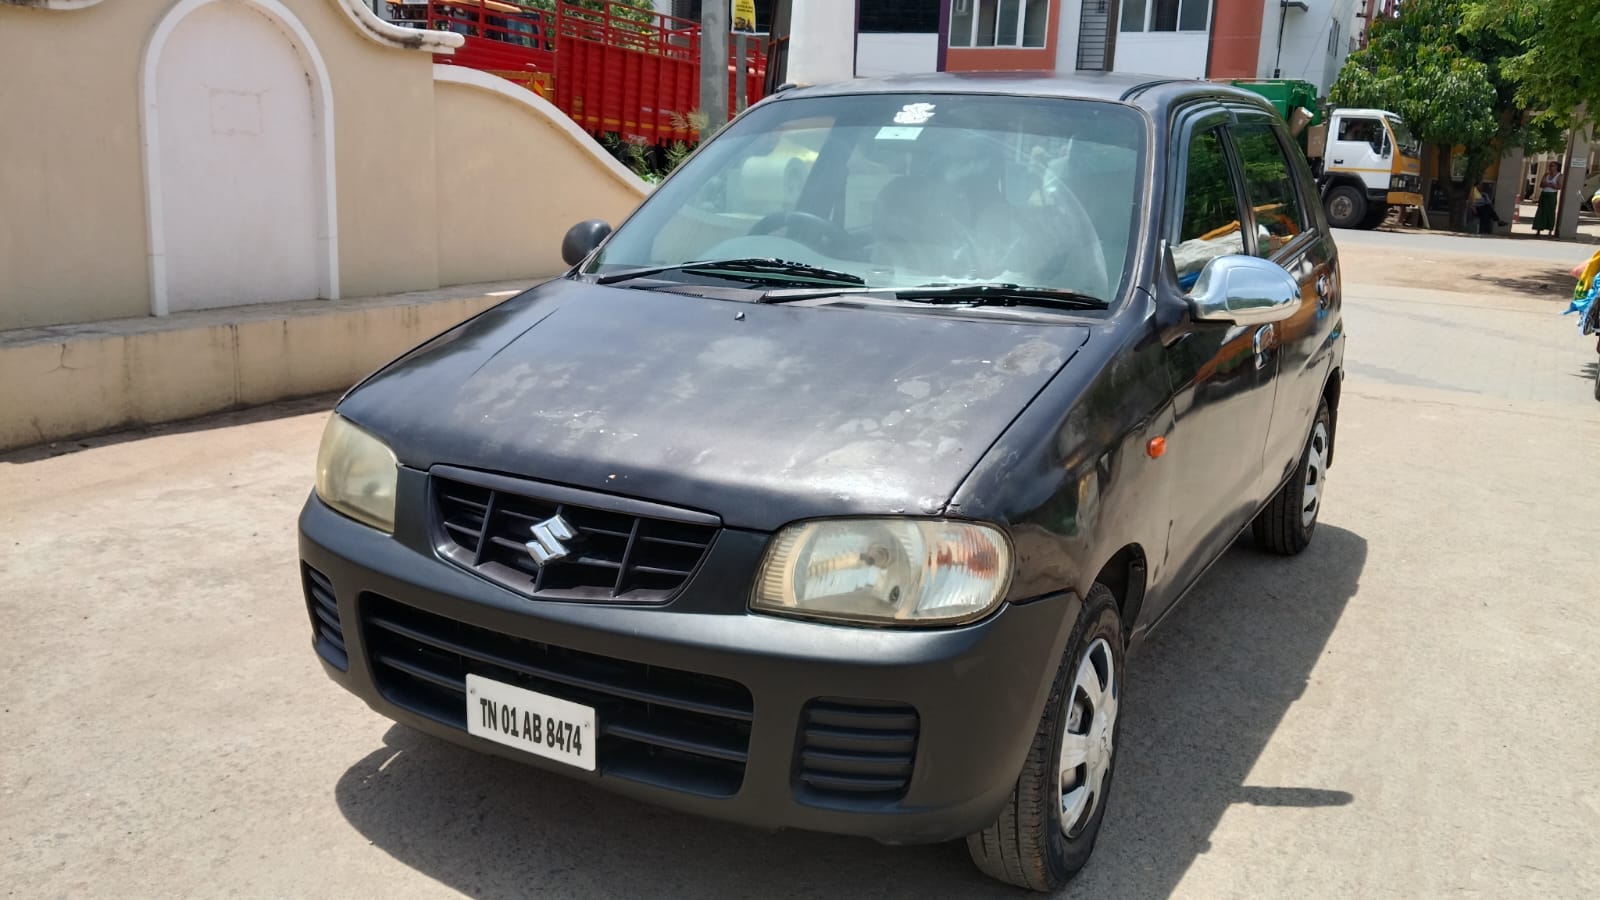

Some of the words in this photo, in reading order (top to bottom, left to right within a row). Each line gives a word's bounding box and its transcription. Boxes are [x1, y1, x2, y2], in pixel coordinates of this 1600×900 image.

[480, 697, 498, 731] TN
[501, 704, 519, 737] 01
[522, 710, 542, 744] AB
[546, 717, 582, 756] 8474
